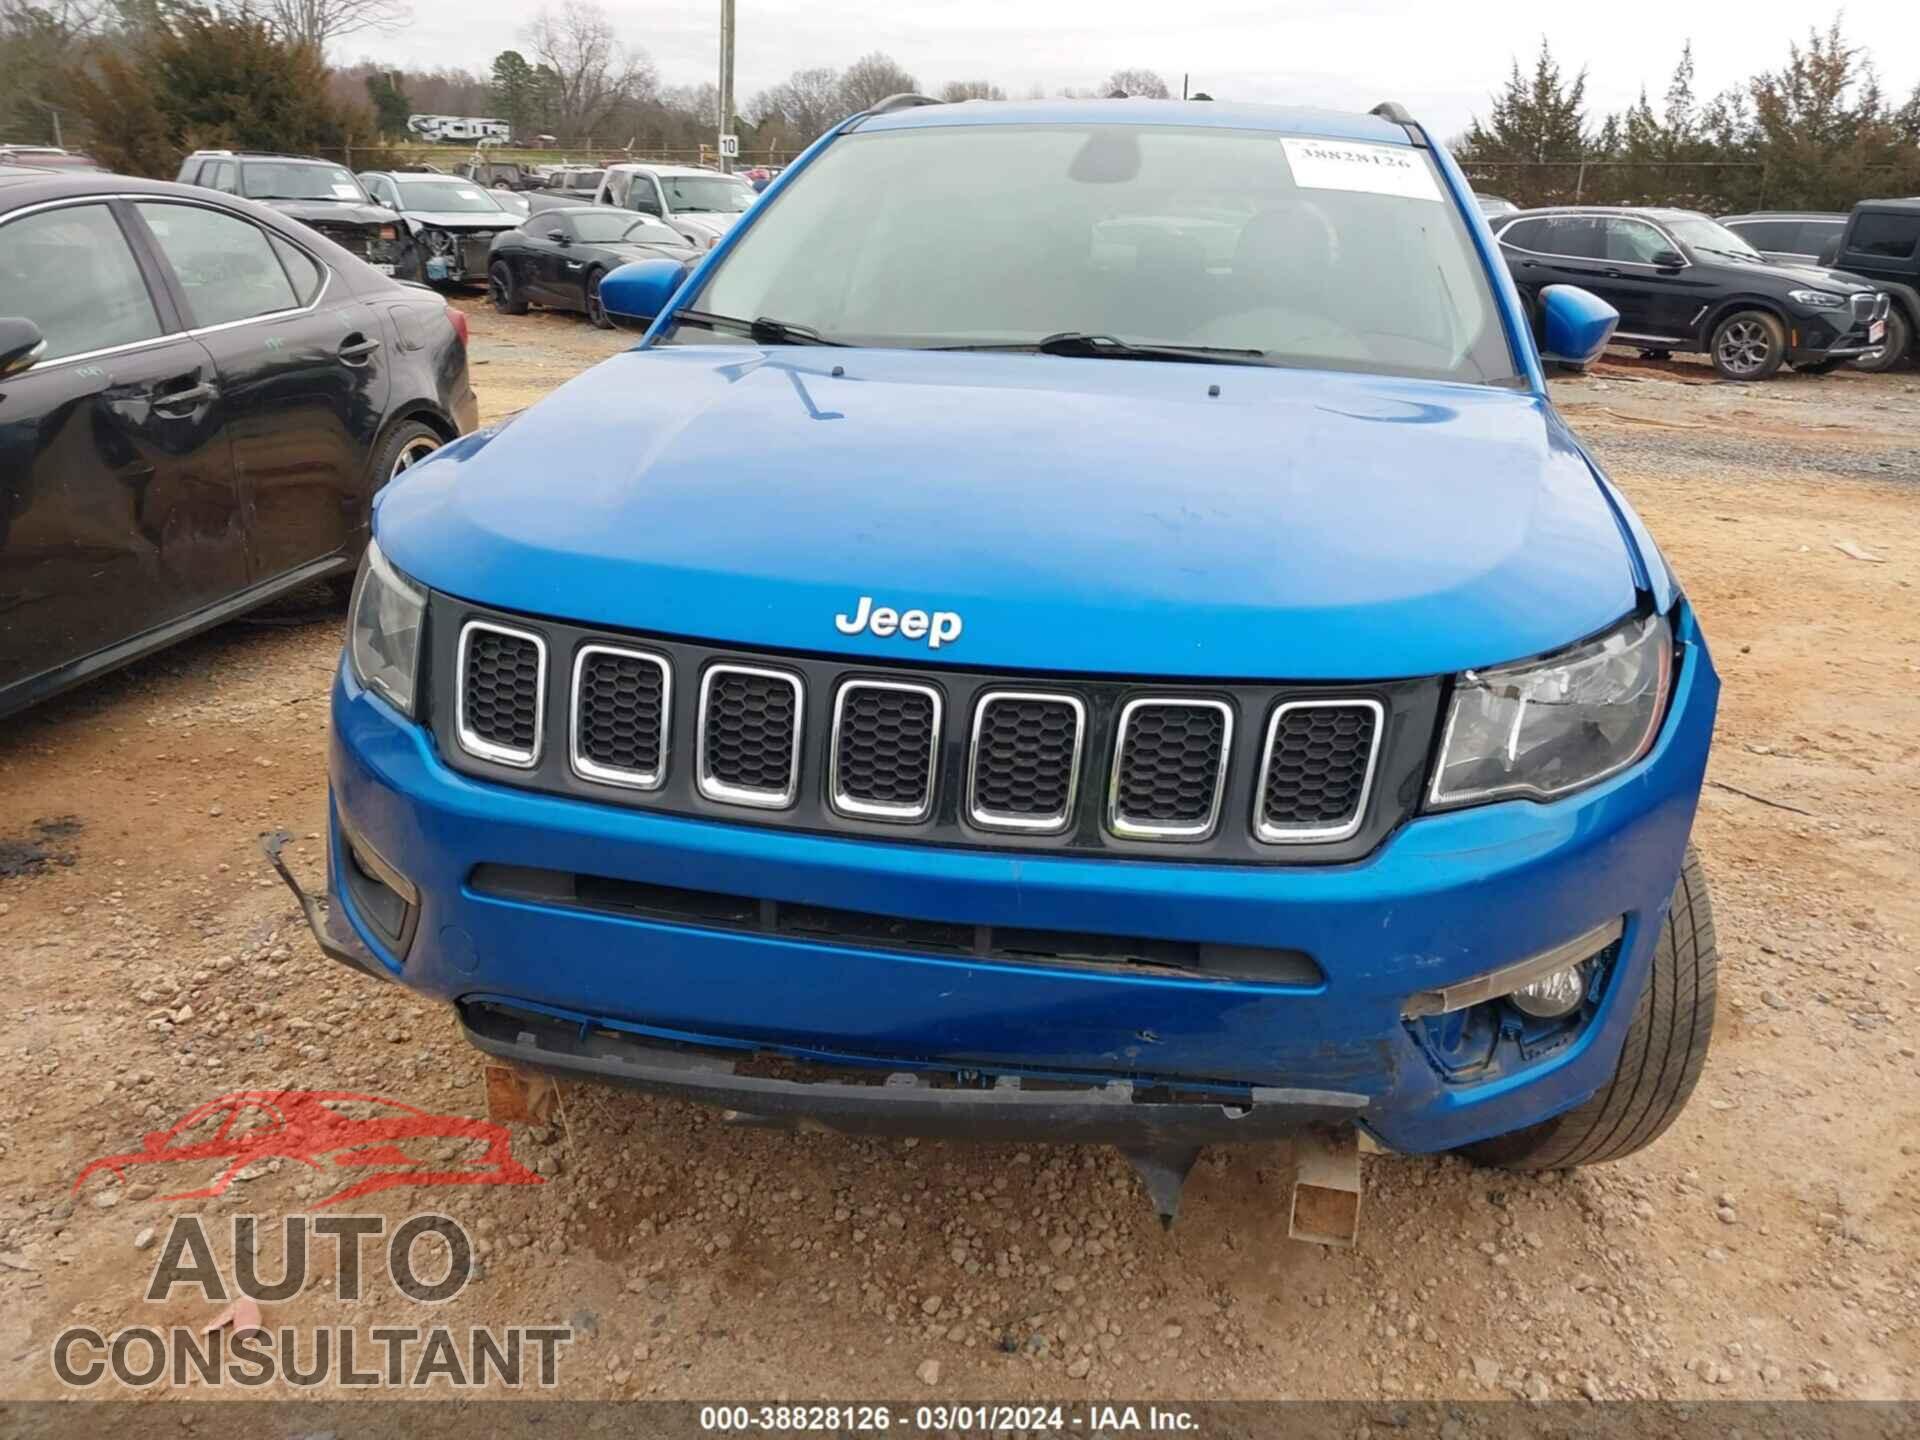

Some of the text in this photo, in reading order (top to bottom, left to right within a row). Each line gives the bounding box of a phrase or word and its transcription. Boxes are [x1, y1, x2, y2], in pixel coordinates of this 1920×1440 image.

[722, 138, 736, 154] 10
[1301, 147, 1412, 169] 38828126
[835, 596, 963, 648] Jeep
